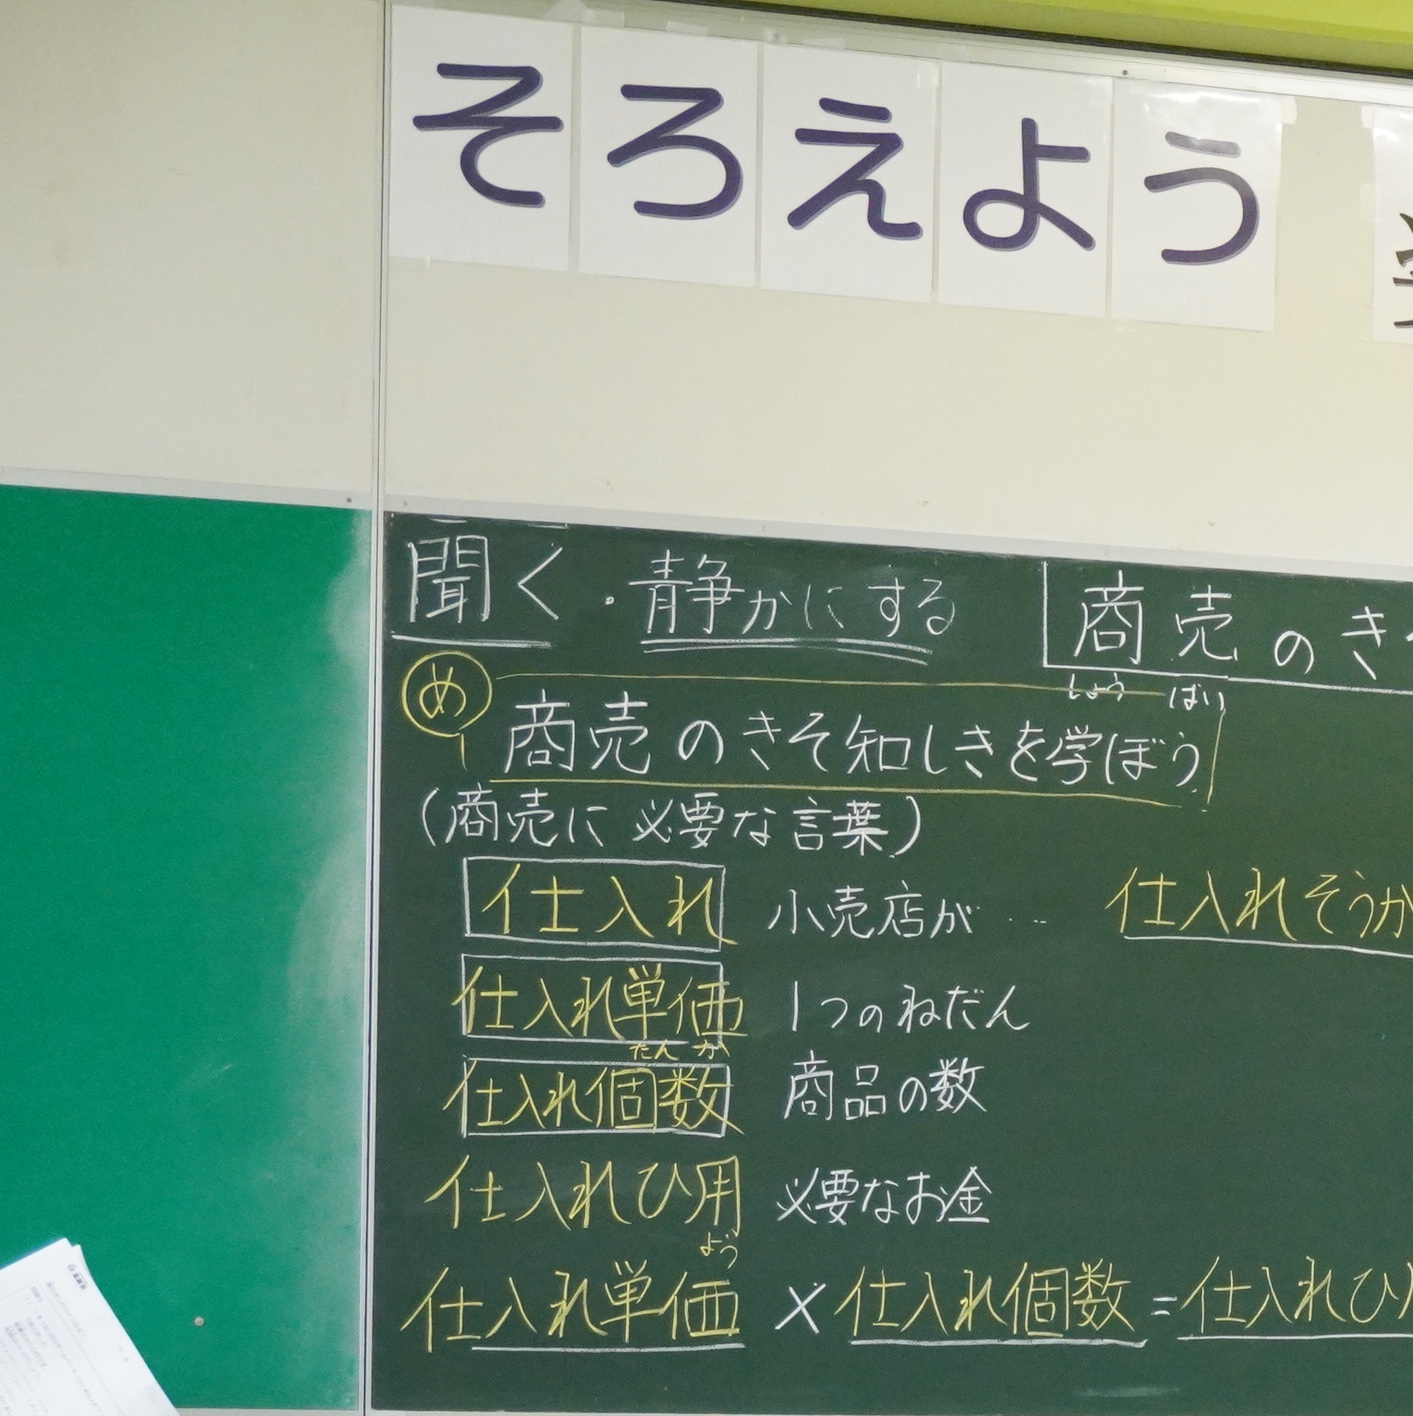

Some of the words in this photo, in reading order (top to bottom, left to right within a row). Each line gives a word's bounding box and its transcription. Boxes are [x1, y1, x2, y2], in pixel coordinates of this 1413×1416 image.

[412, 62, 1260, 266] そろえよう
[503, 690, 1199, 787] 商売のきそ知しきを学ぼう
[482, 864, 738, 945] 仕入れ
[451, 963, 748, 1039] 仕入れ単価
[442, 1060, 745, 1135] 仕入れ個数
[783, 1050, 988, 1121] 商品の数
[424, 1154, 742, 1238] 仕入れひ用
[776, 1165, 994, 1227] 必要なお金
